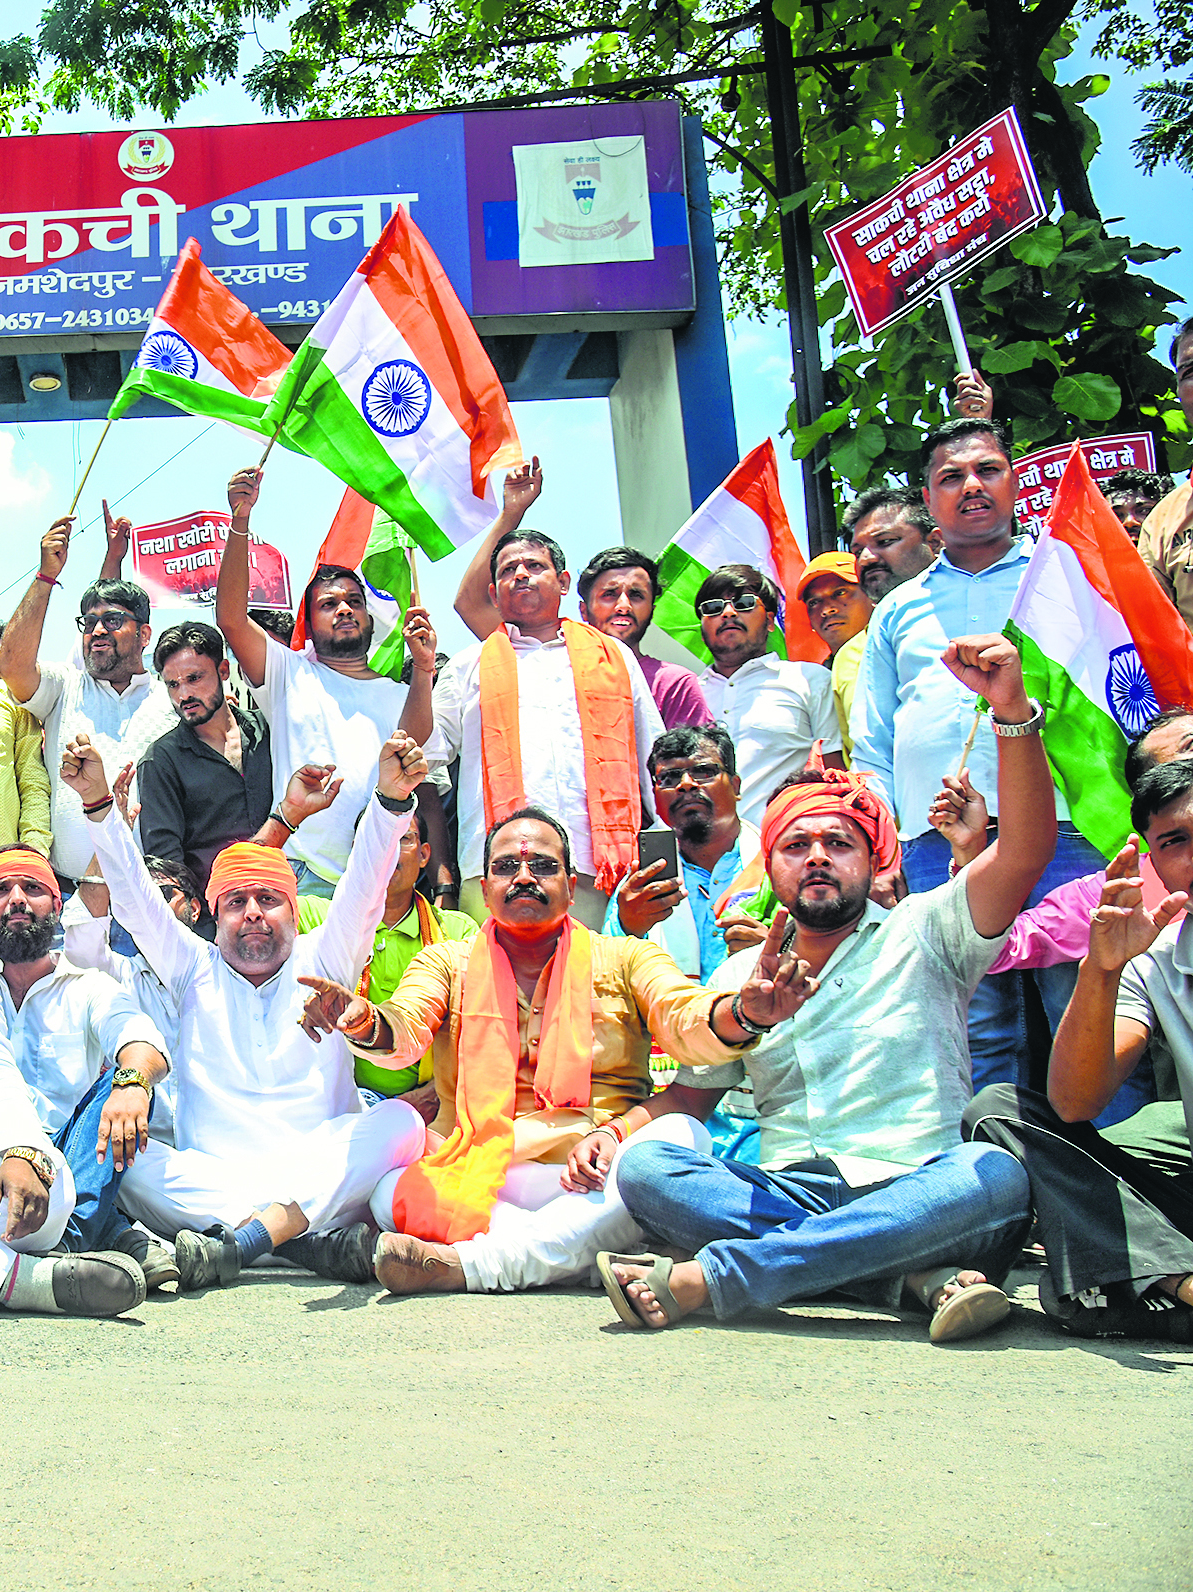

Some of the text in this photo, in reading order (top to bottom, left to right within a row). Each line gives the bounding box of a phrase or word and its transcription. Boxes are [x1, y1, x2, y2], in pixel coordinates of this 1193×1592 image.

[851, 136, 994, 247] साकची थाना क्षेत्र मे
[865, 235, 896, 265] चल
[894, 217, 918, 246] रहे
[916, 192, 957, 231] अवैध
[931, 218, 960, 245] बंद
[905, 280, 927, 296] जन
[1089, 447, 1118, 470] क्षेत्र
[1117, 444, 1135, 467] मे
[139, 535, 176, 556] नशा
[176, 521, 216, 549] खोरी
[163, 549, 216, 575] लगाना
